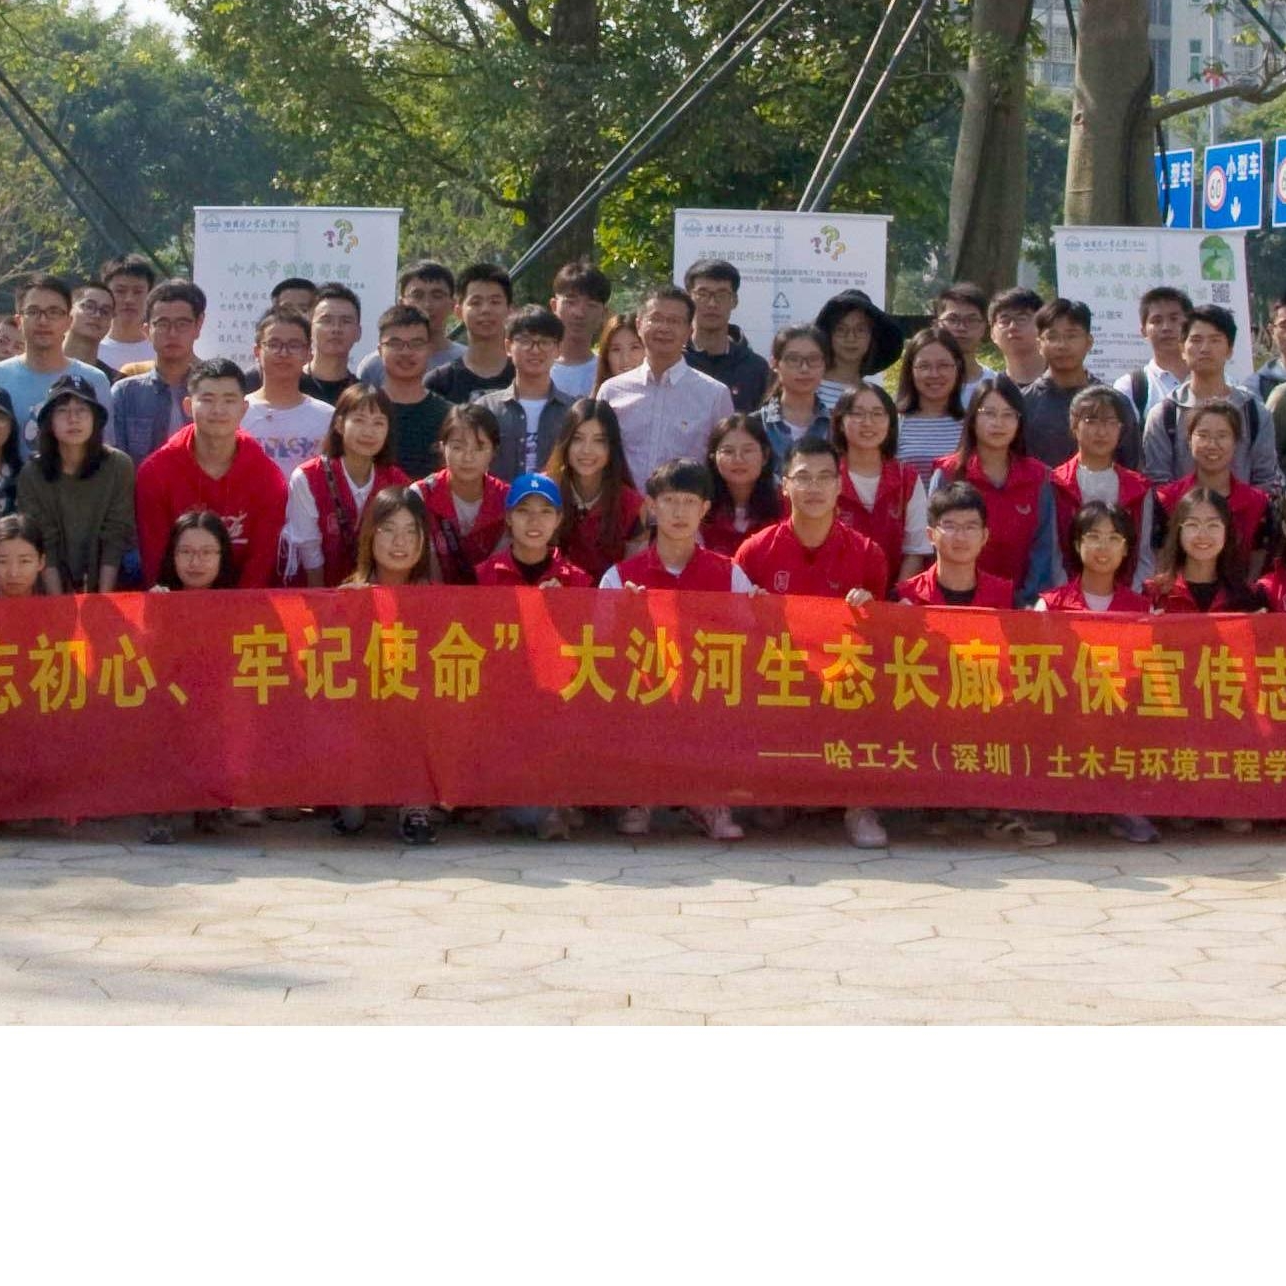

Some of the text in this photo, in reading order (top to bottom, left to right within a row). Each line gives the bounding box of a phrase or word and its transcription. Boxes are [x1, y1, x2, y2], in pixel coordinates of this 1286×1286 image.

[1226, 150, 1260, 183] 小型车
[1209, 174, 1222, 201] 60
